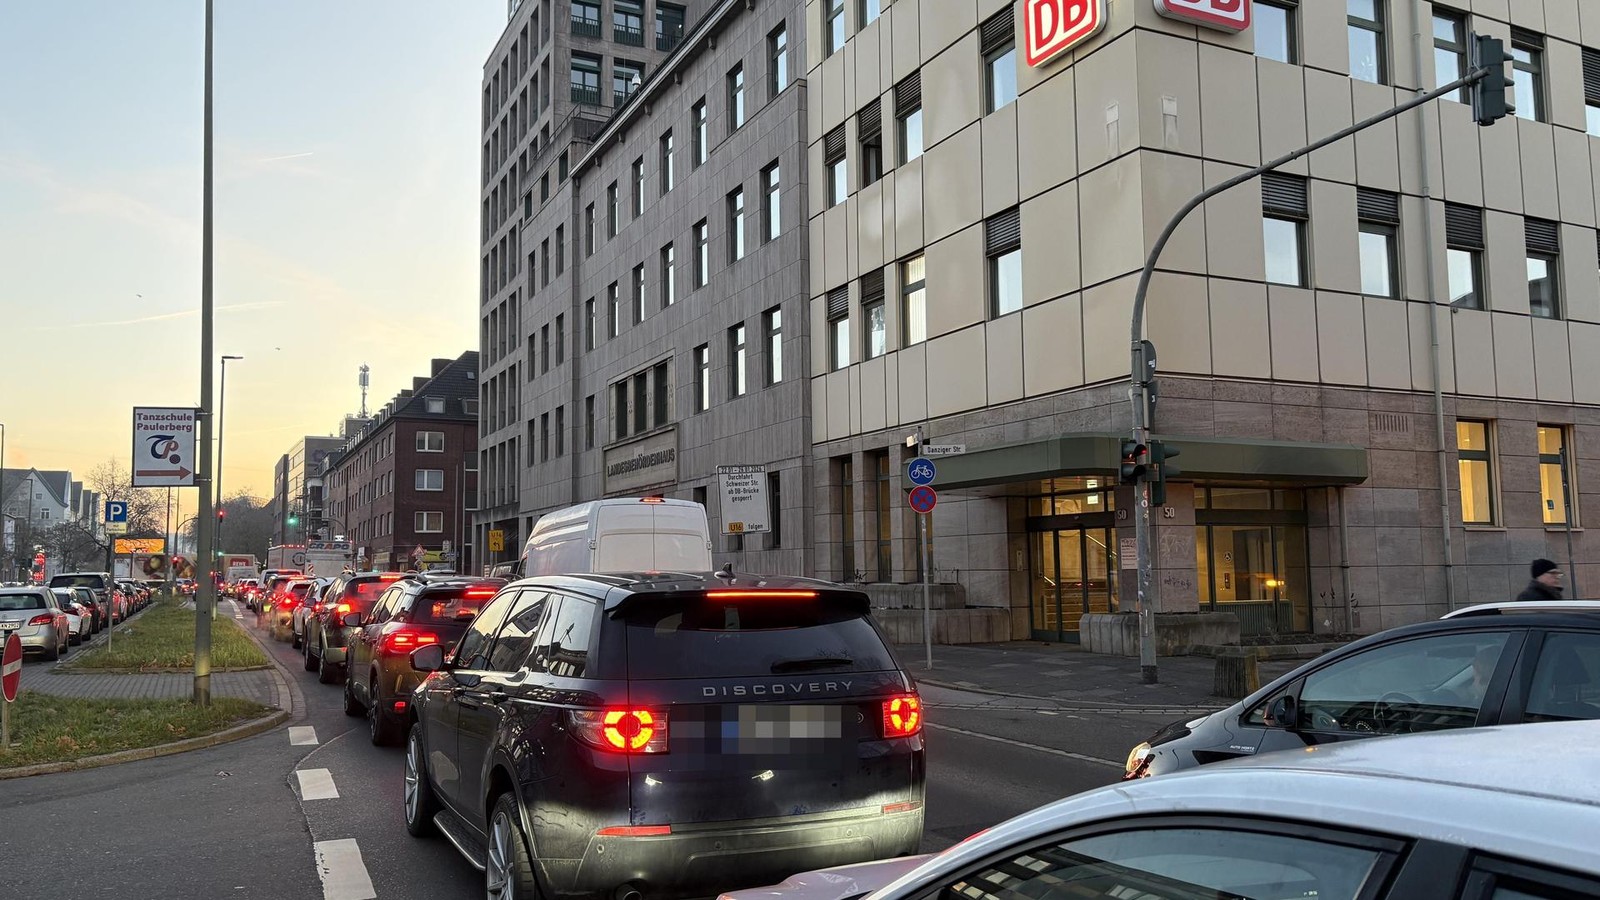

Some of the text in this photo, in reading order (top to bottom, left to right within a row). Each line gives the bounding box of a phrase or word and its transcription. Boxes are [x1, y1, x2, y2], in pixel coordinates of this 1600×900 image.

[1034, 0, 1088, 51] DB
[137, 413, 192, 421] Tanzschule
[137, 423, 192, 433] Paulerberg
[928, 446, 951, 454] Danziger
[607, 448, 675, 478] LANDESBEHÖRDENHAUS
[110, 504, 123, 521] P
[1118, 510, 1126, 519] 50
[1164, 507, 1174, 518] 50
[702, 680, 853, 697] DISCOVERY
